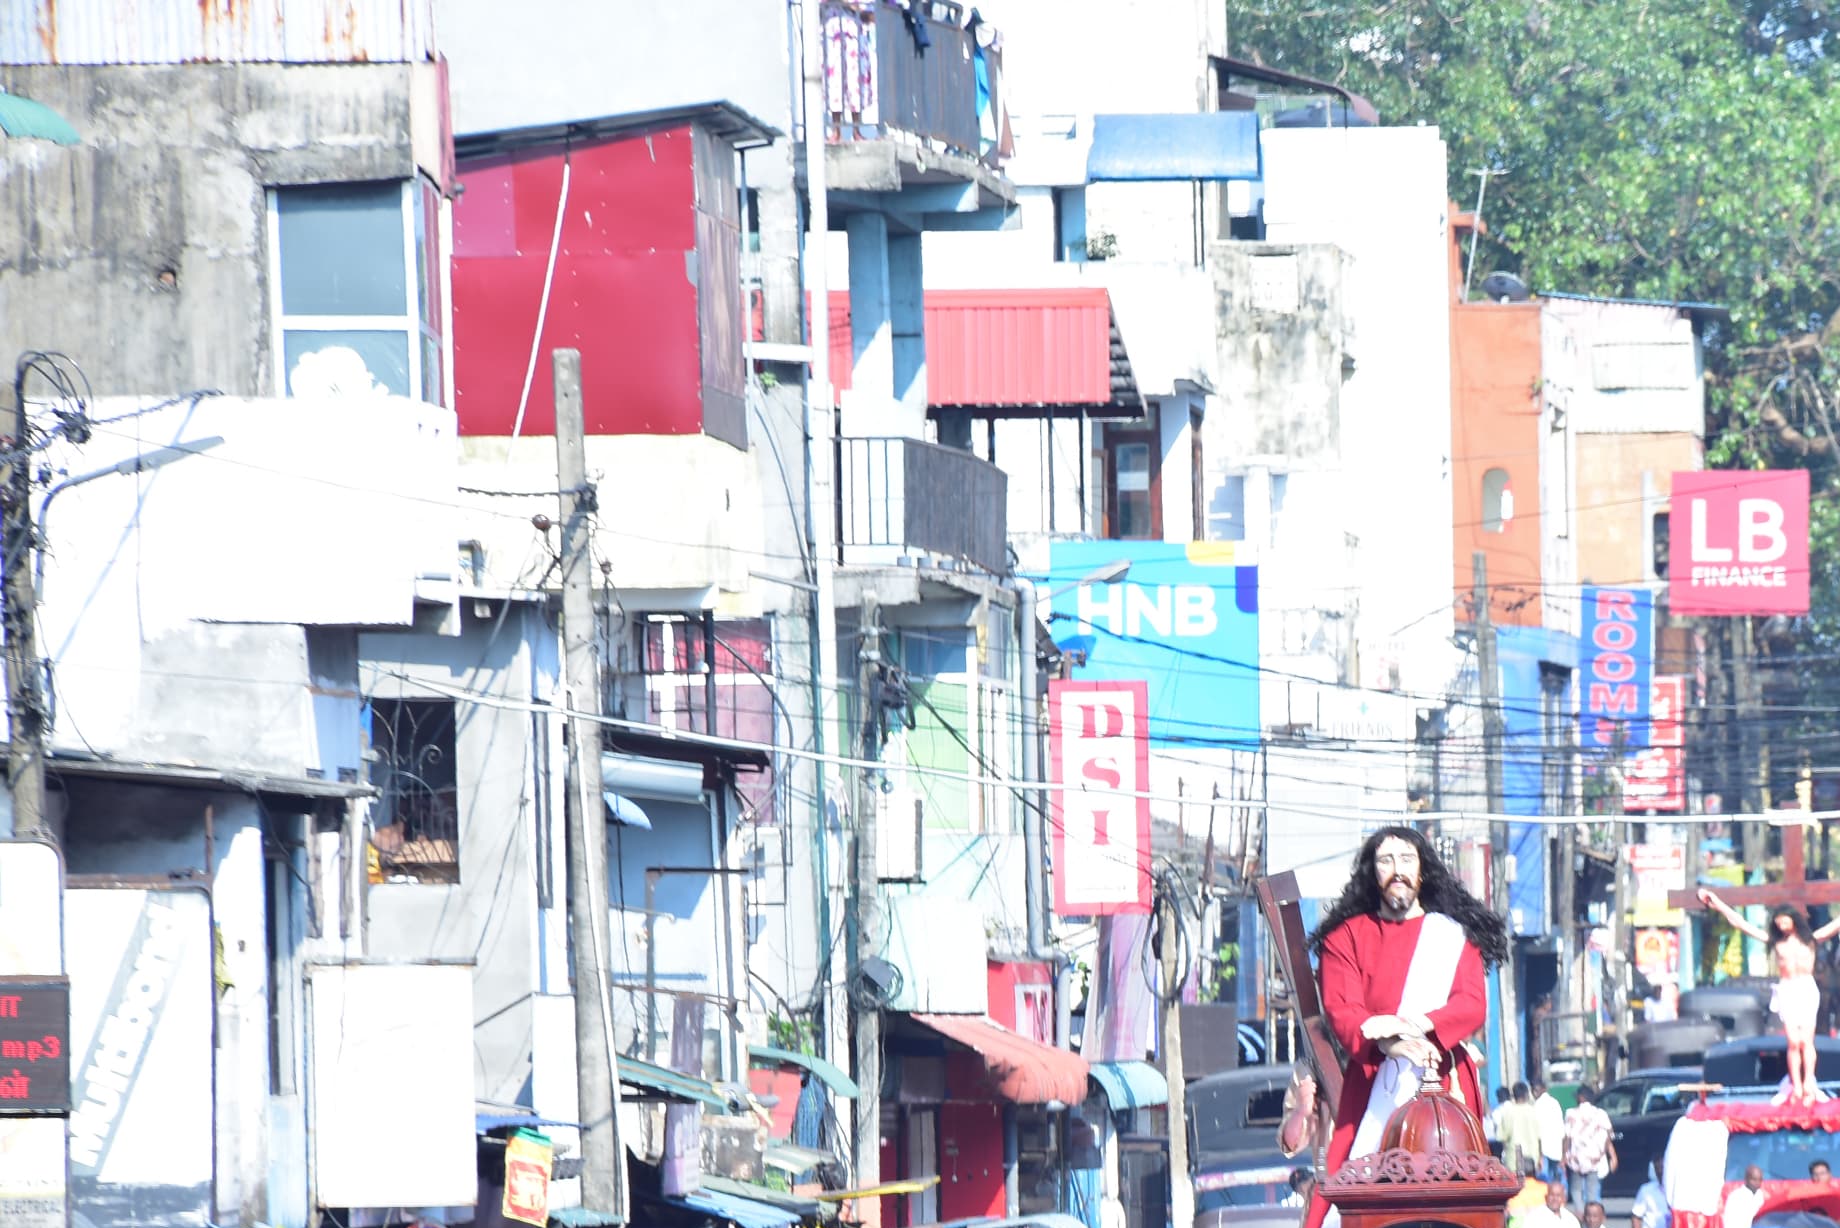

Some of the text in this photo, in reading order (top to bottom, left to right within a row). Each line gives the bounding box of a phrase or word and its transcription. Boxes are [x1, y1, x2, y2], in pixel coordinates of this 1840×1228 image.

[1691, 498, 1787, 562] LB
[1691, 566, 1787, 587] FINANCE
[1077, 583, 1218, 637] HNB
[1078, 703, 1125, 846] DSI
[1, 1035, 61, 1063] mp3
